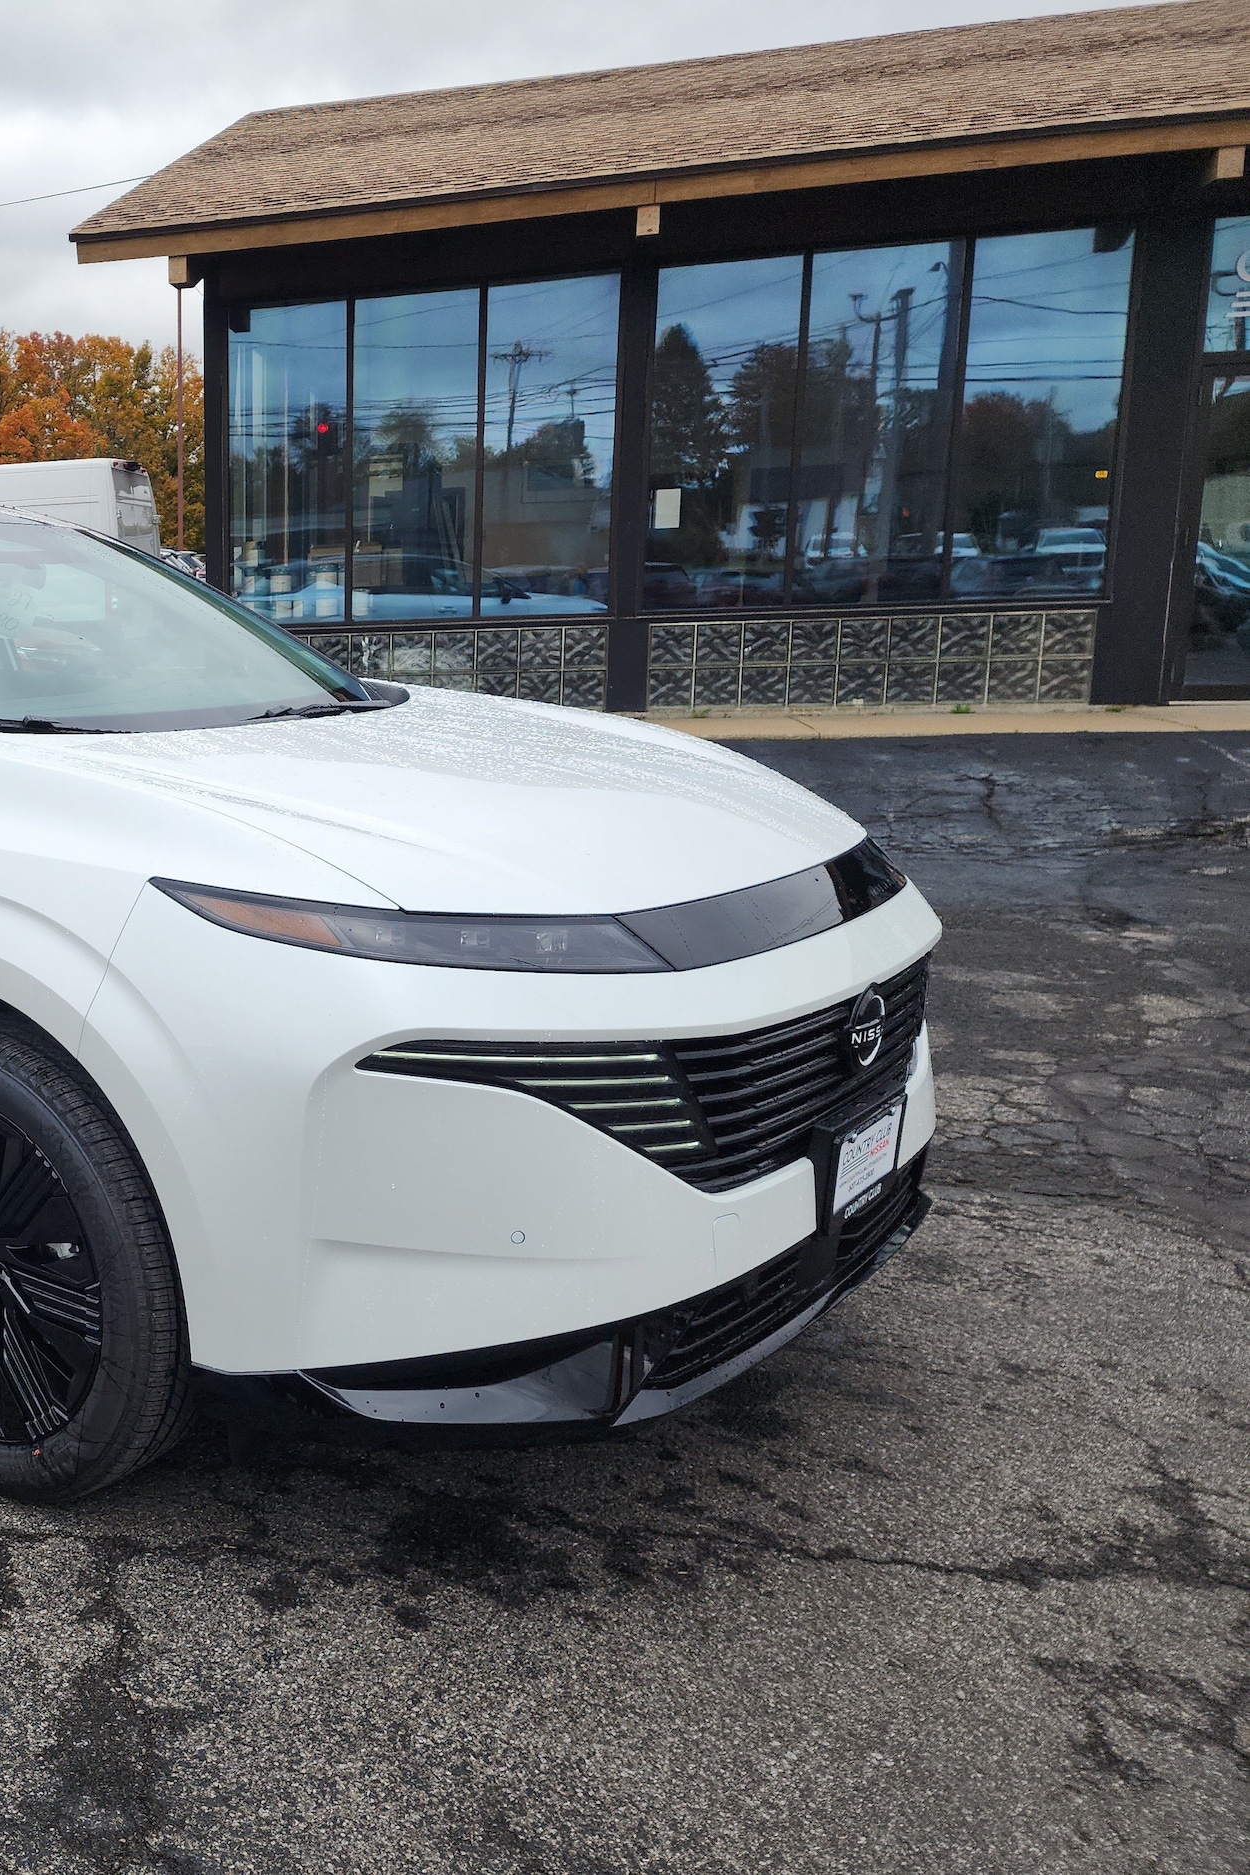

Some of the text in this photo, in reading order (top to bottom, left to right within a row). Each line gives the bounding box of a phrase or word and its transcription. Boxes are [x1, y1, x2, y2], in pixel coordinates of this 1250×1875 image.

[851, 1025, 882, 1044] NISS
[842, 1122, 893, 1166] COUNTRY CLUB
[868, 1138, 890, 1157] NISSAN
[844, 1182, 882, 1219] COUNTRY CLUB
